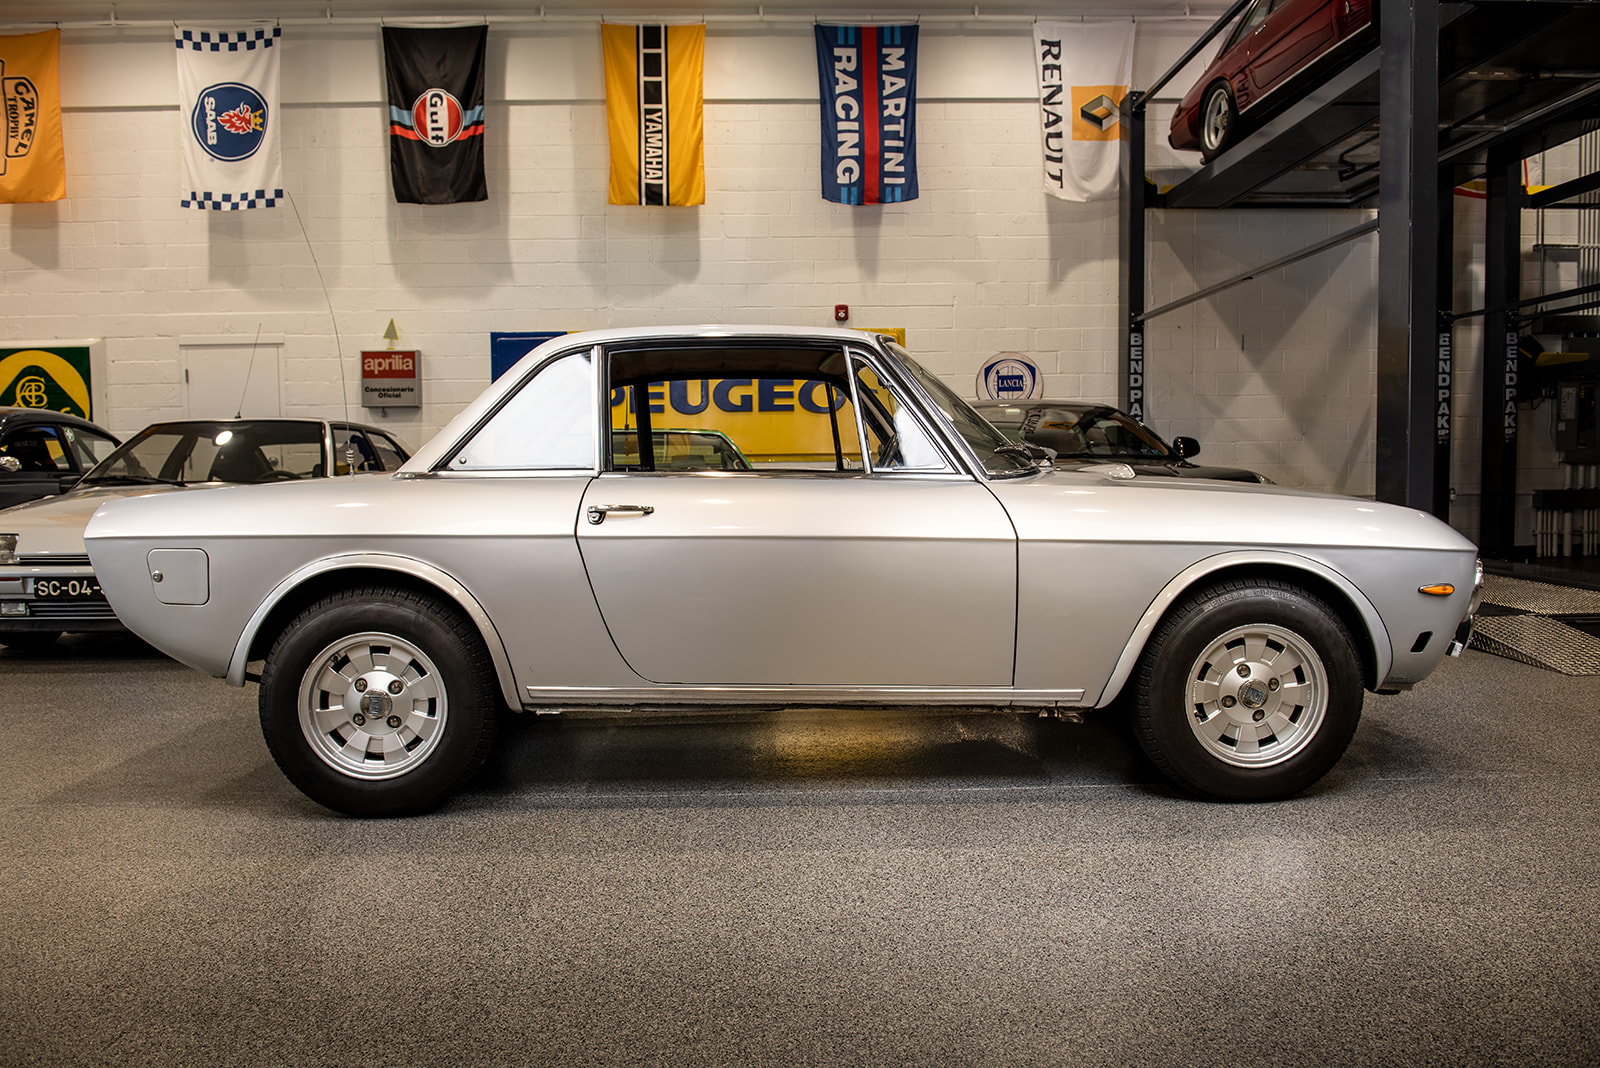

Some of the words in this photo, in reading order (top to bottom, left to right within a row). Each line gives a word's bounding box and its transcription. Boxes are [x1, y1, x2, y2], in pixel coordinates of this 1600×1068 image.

[8, 96, 19, 140] TROPHY
[14, 81, 35, 153] CAMEL
[204, 96, 218, 145] SAAB
[429, 92, 444, 144] Gulf
[833, 47, 860, 184] RACING
[882, 47, 906, 184] MARTINI
[645, 112, 663, 179] YAMAHA
[363, 354, 414, 375] aprilia
[999, 378, 1024, 388] LANCIA
[1130, 332, 1143, 421] BENDPA
[1437, 333, 1450, 428] BENDPAK
[1504, 332, 1518, 427] BENDPAK
[611, 379, 877, 414] EUGEO
[37, 580, 105, 596] SC-04-
